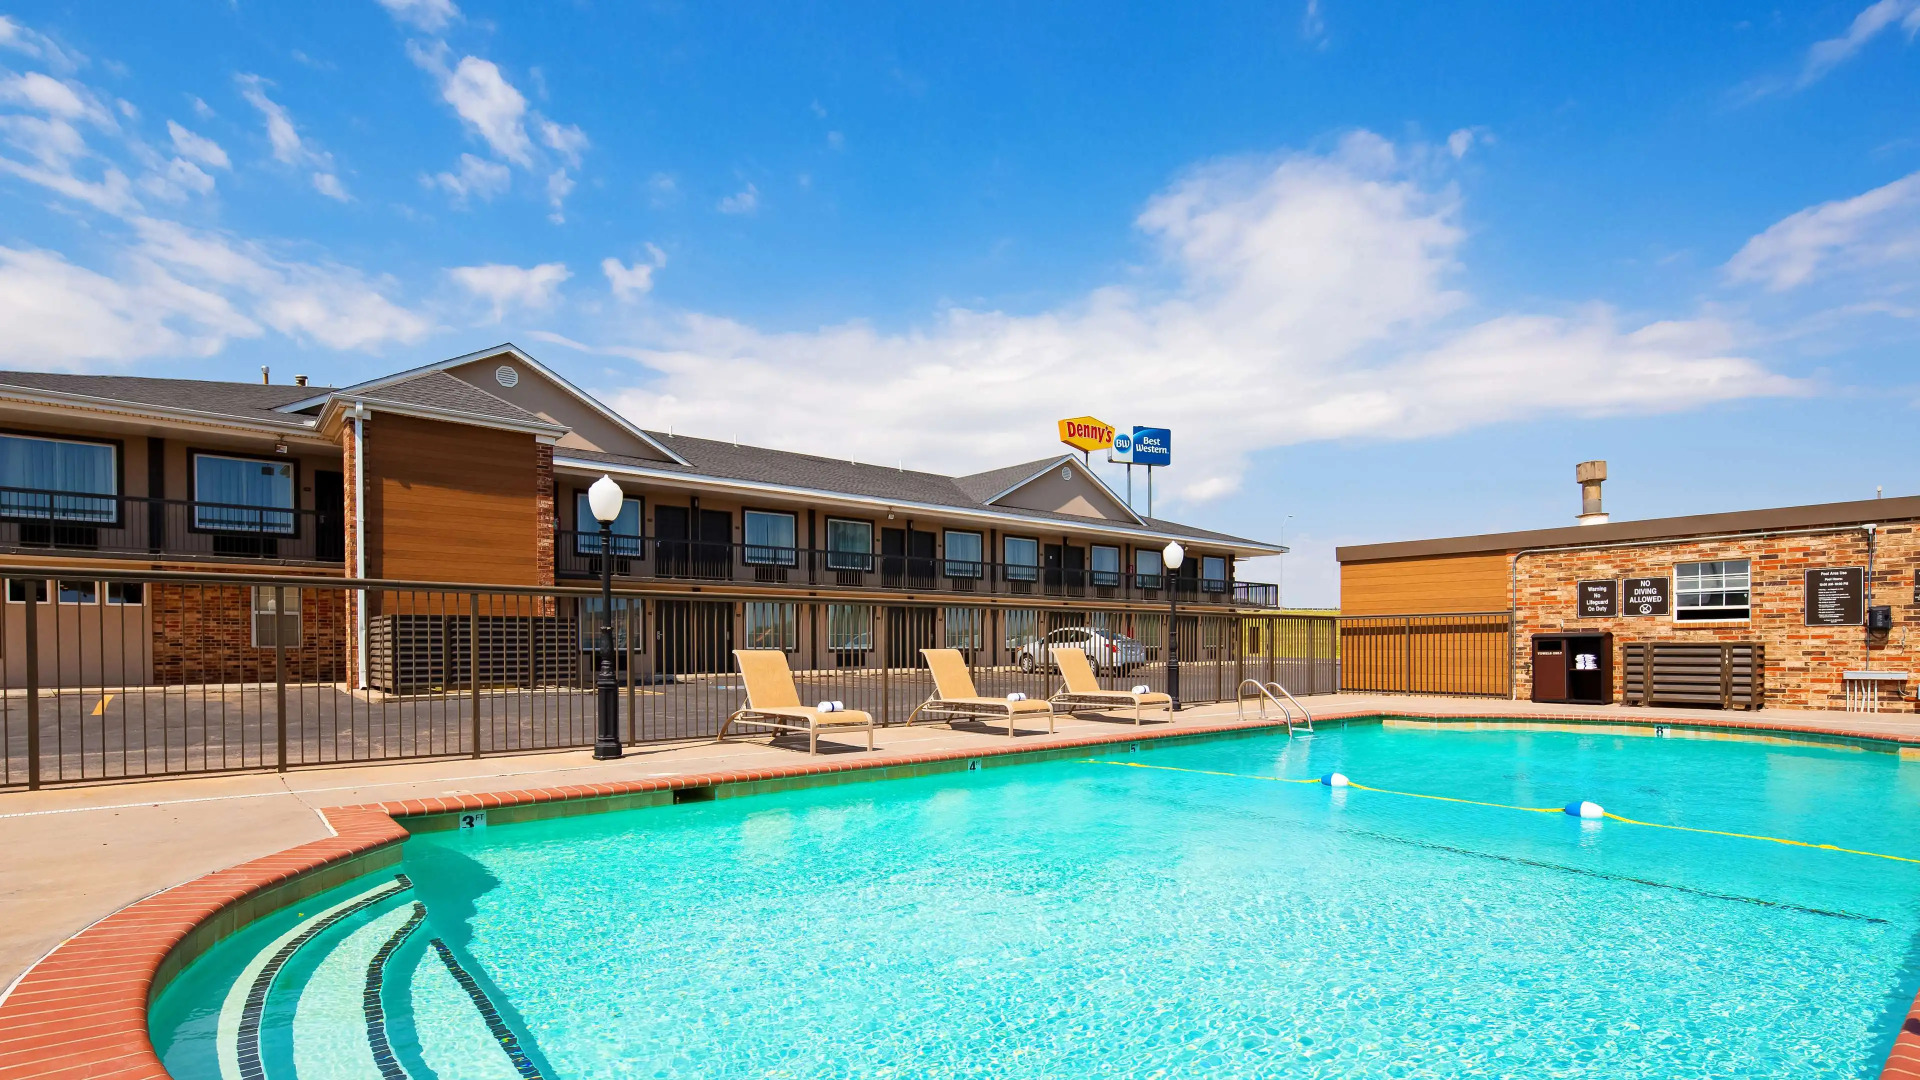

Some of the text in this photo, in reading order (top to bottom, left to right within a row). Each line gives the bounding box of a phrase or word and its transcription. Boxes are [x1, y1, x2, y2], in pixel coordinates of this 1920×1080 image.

[1066, 421, 1112, 443] Denny's
[1116, 439, 1130, 448] BW
[1143, 436, 1161, 446] Best
[1135, 443, 1168, 454] Western
[1656, 725, 1664, 738] 8
[1131, 743, 1136, 753] 5
[969, 760, 976, 770] 4
[462, 815, 475, 829] 3
